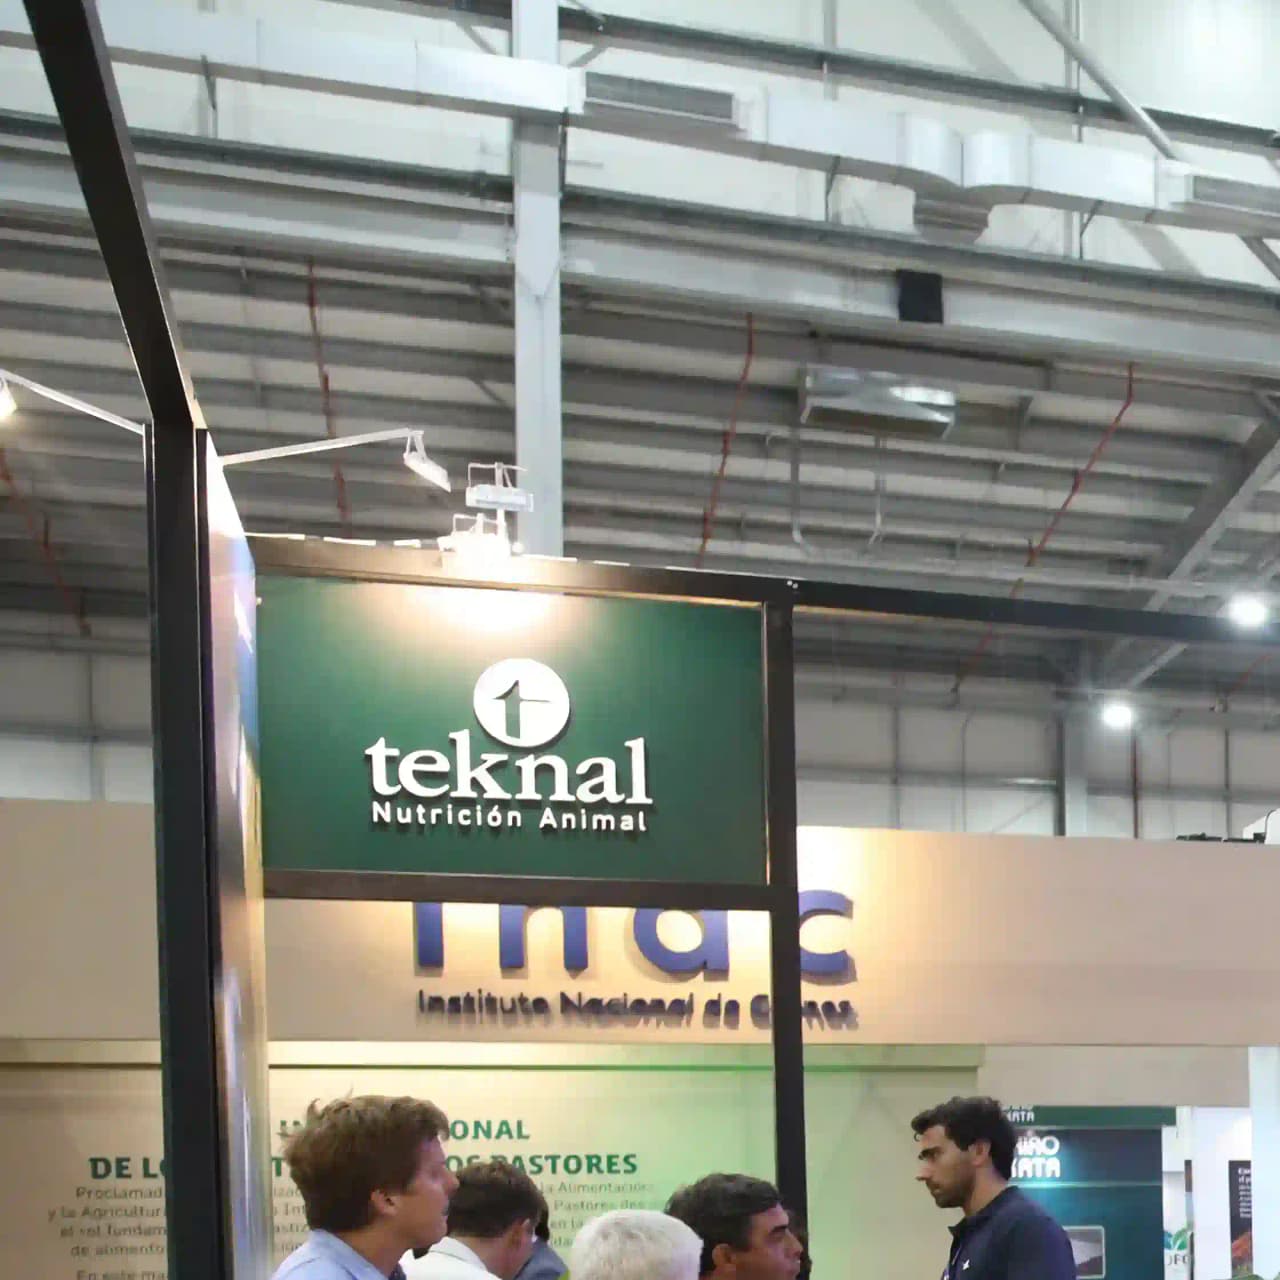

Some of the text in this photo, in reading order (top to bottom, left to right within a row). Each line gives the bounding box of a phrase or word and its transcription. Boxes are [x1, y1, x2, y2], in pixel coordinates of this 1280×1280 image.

[365, 729, 653, 804] teknal
[372, 801, 647, 832] Nutrición Animal
[88, 1157, 132, 1180] DE
[76, 1187, 162, 1199] Proclamad
[81, 1206, 163, 1219] Agricultur
[96, 1245, 164, 1255] alimento
